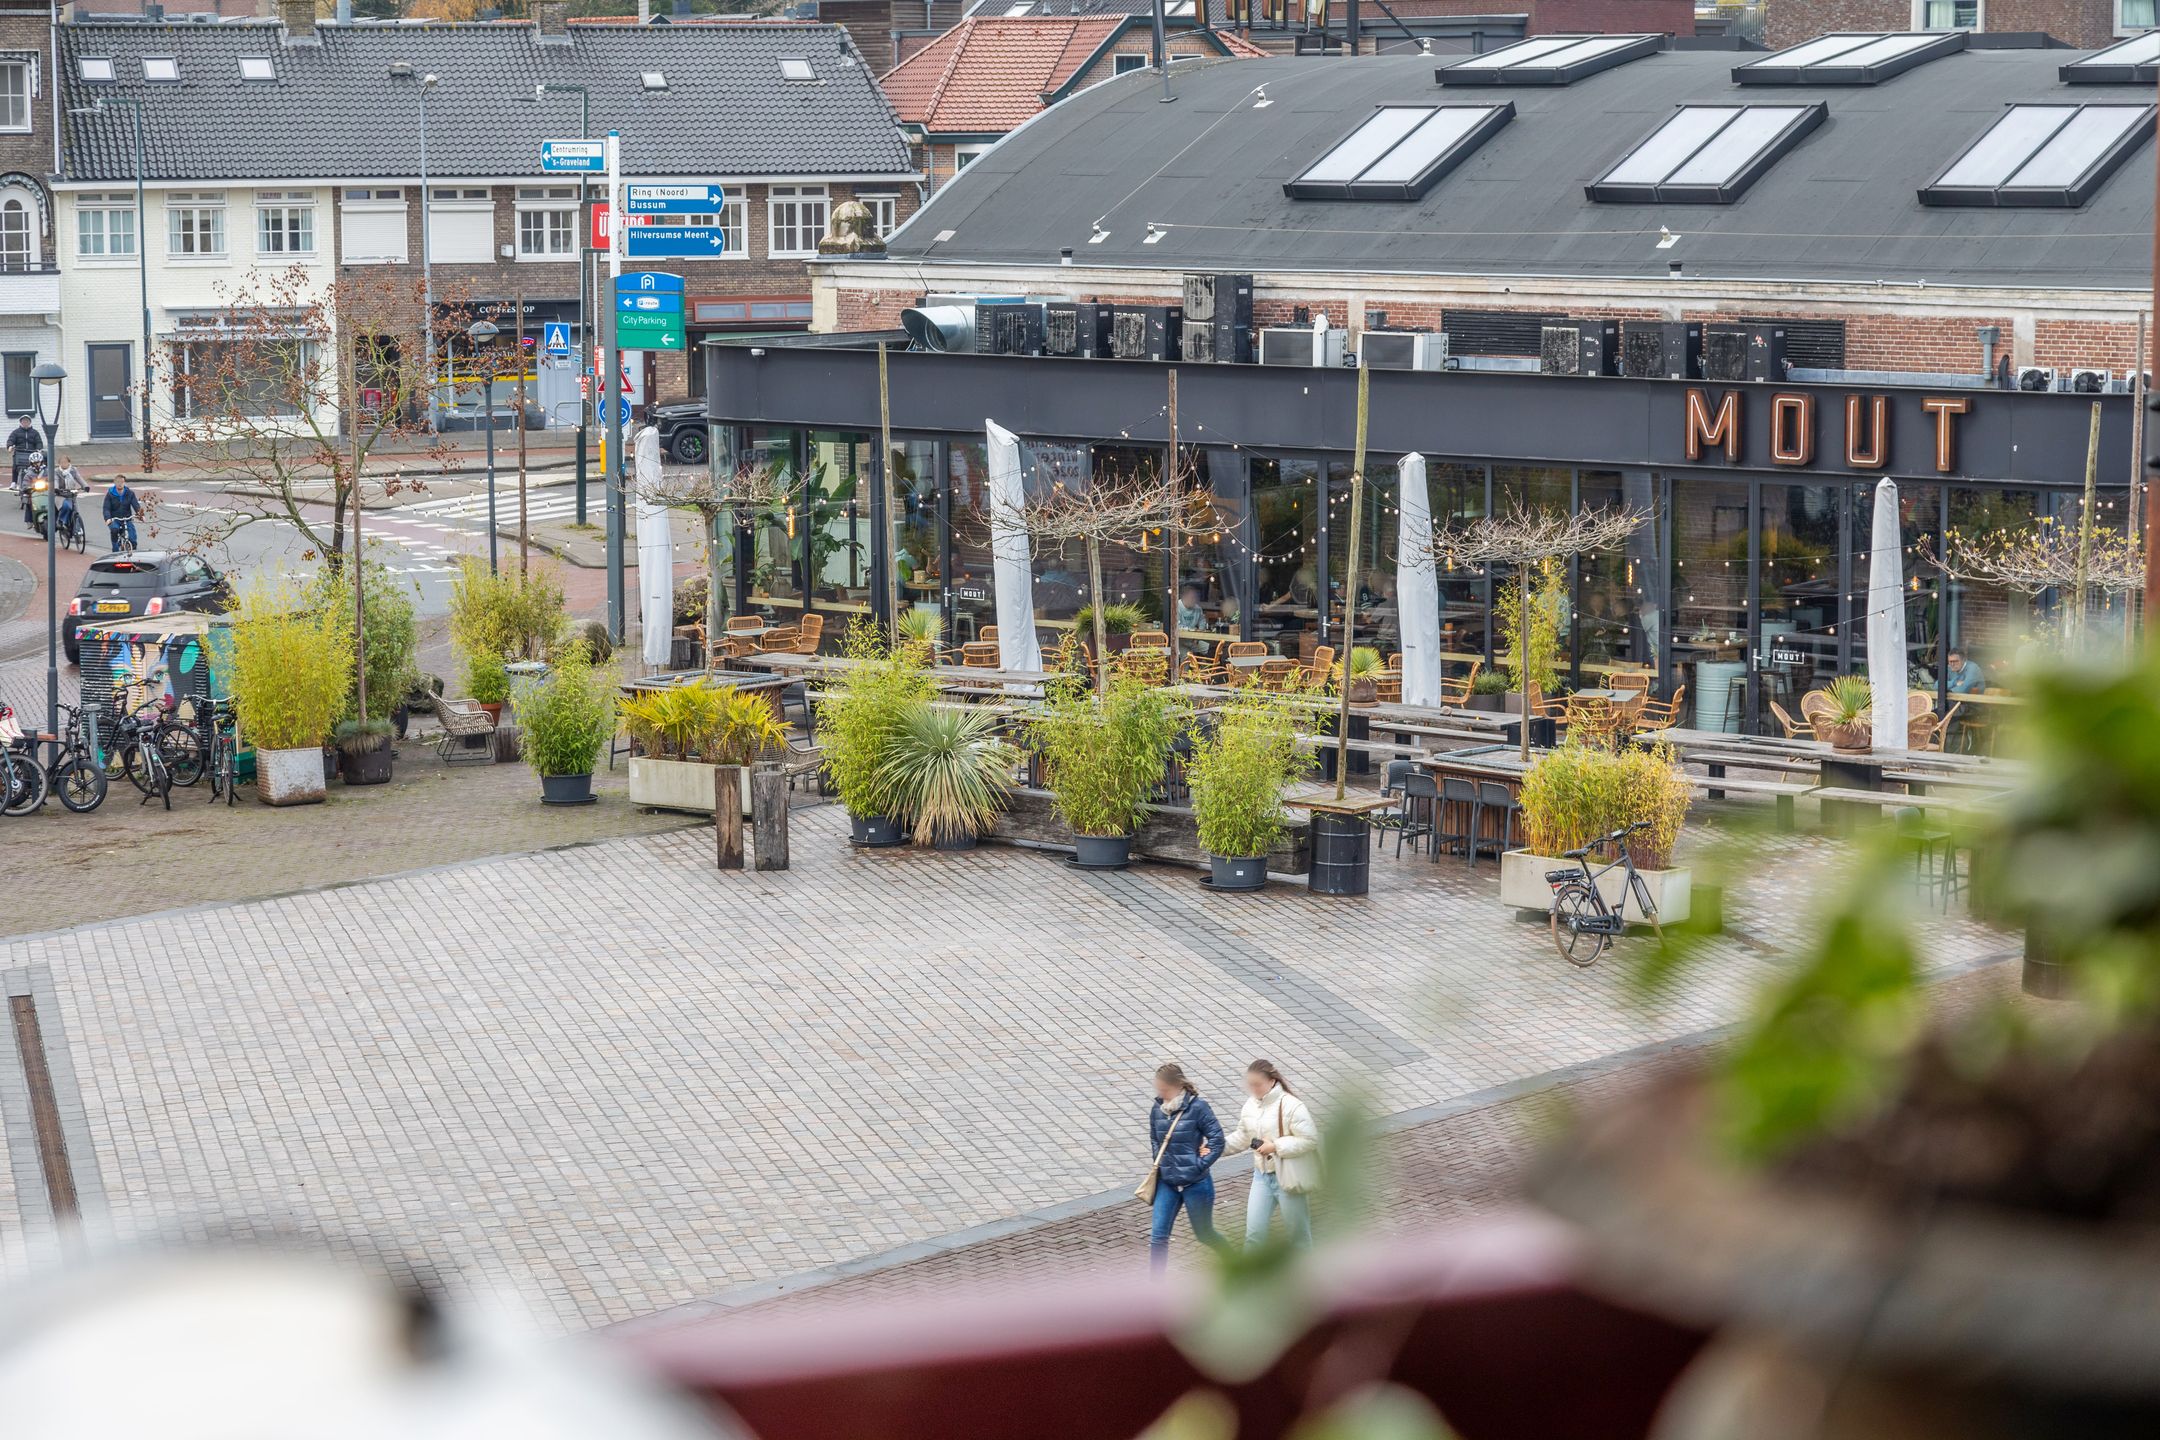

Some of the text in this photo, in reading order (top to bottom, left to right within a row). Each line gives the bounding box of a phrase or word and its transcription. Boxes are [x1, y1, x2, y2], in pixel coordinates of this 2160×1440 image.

[552, 145, 588, 155] Centrumring
[550, 157, 591, 167] 's-Graveland
[632, 188, 689, 198] Ring (Noord)
[630, 201, 667, 209] Bussum
[630, 231, 710, 240] Hilversumse Meent
[622, 315, 667, 327] City Parking
[1685, 387, 1972, 472] MOUT
[963, 590, 982, 599] MOUT
[1777, 652, 1800, 661] MOUT
